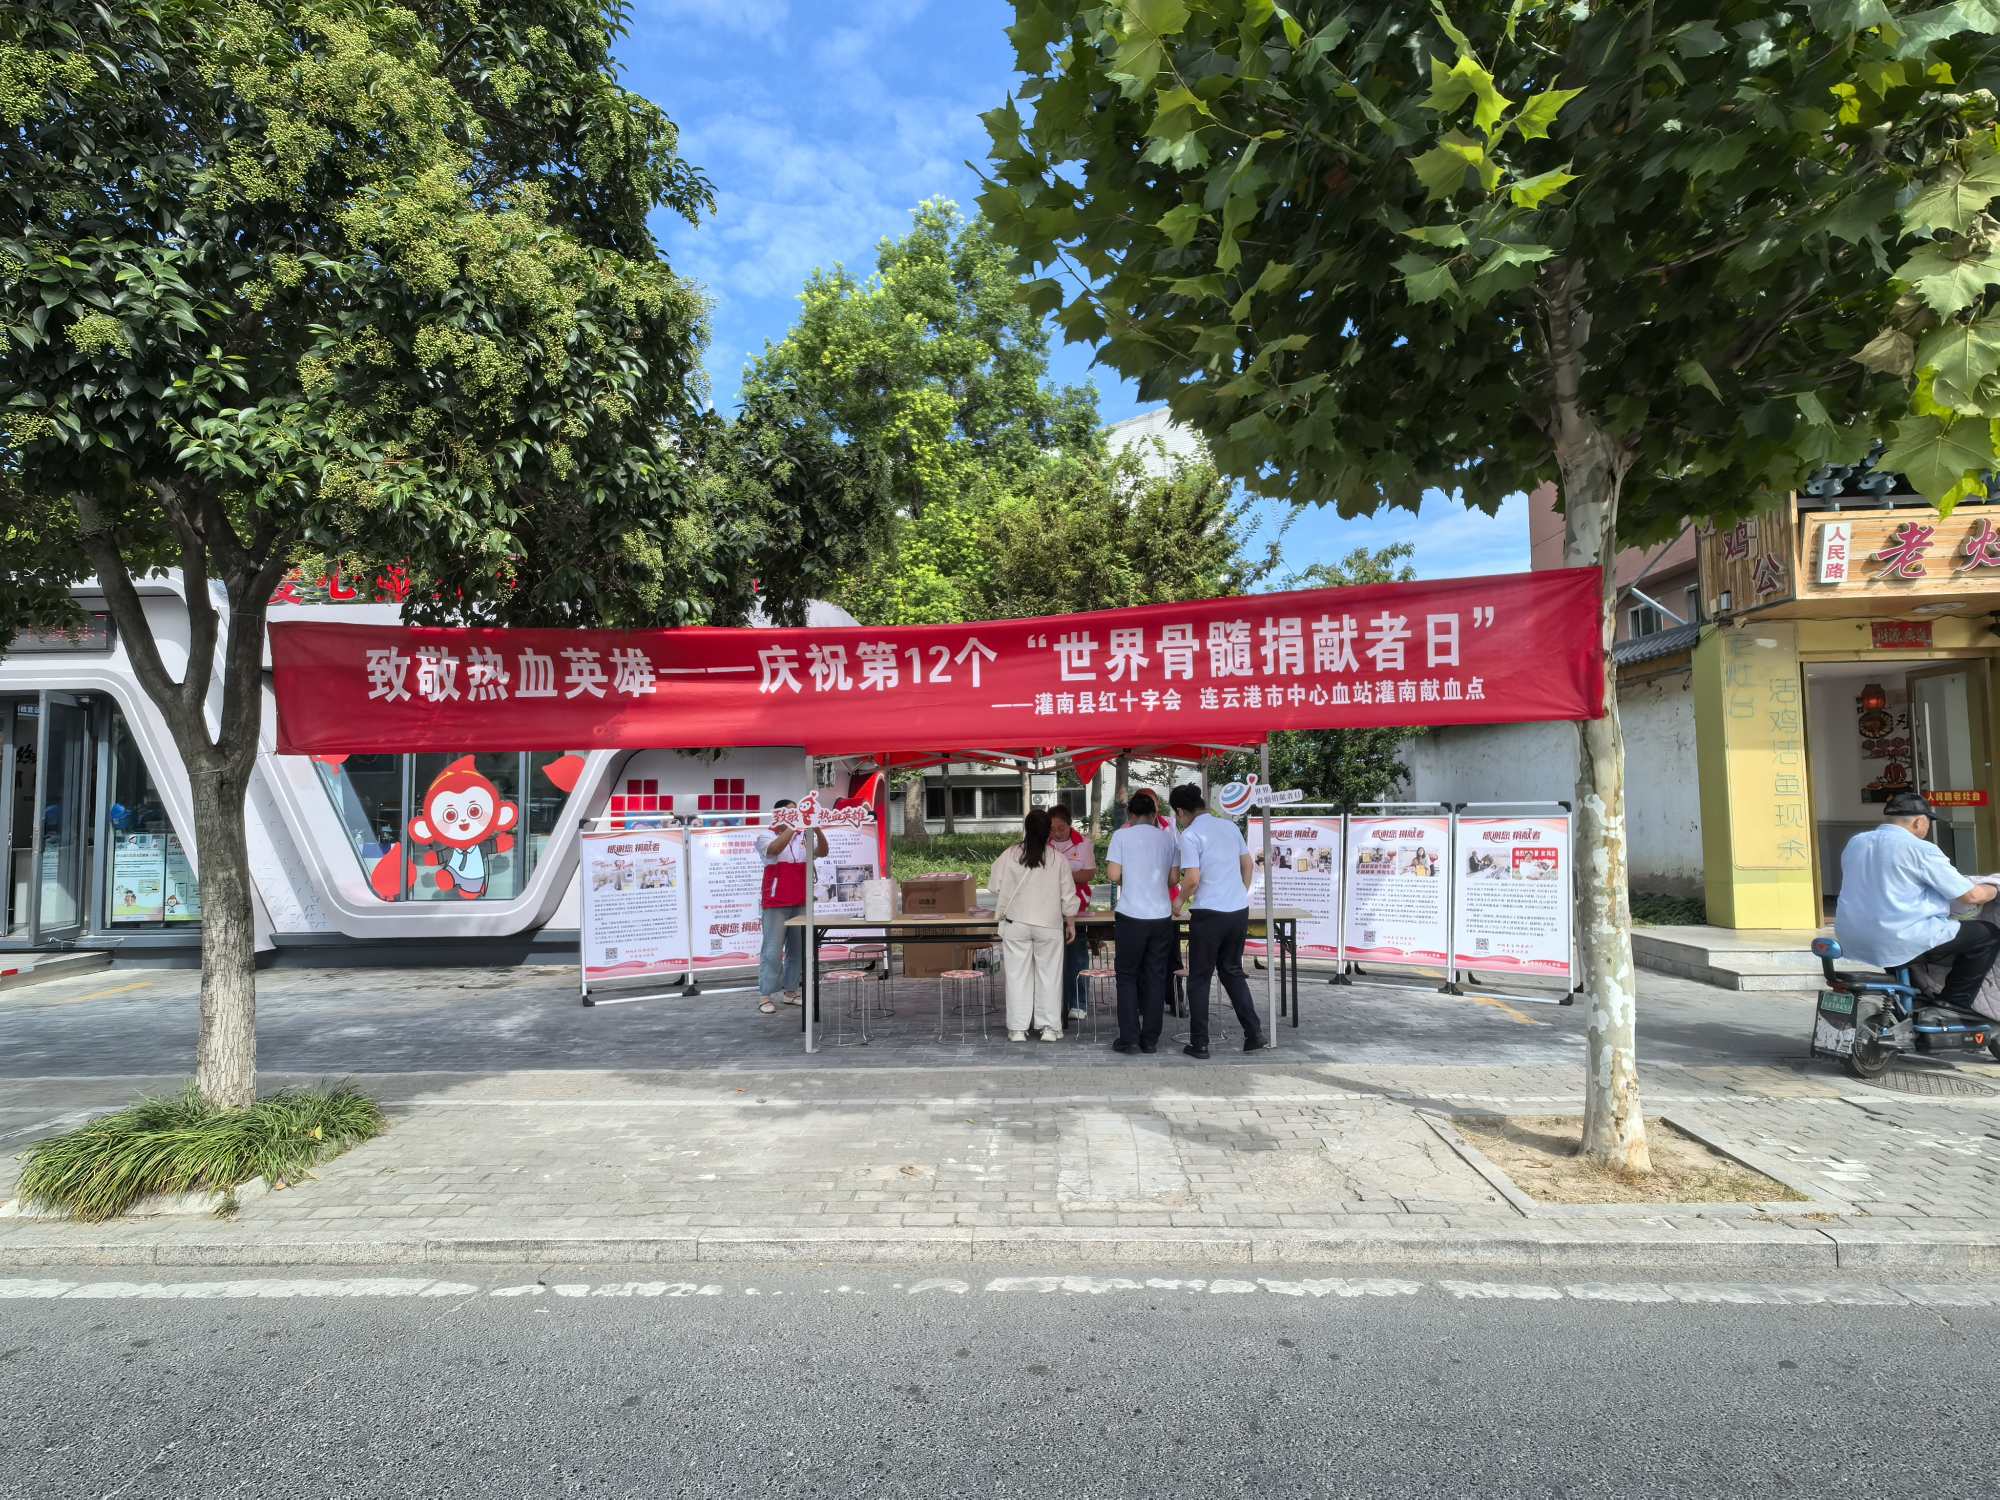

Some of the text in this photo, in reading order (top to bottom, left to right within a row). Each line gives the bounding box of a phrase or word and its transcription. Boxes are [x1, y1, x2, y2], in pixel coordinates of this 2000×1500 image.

[1825, 526, 1847, 580] 人民路
[1200, 676, 1486, 710] 连云港市中心血站灌南献血点
